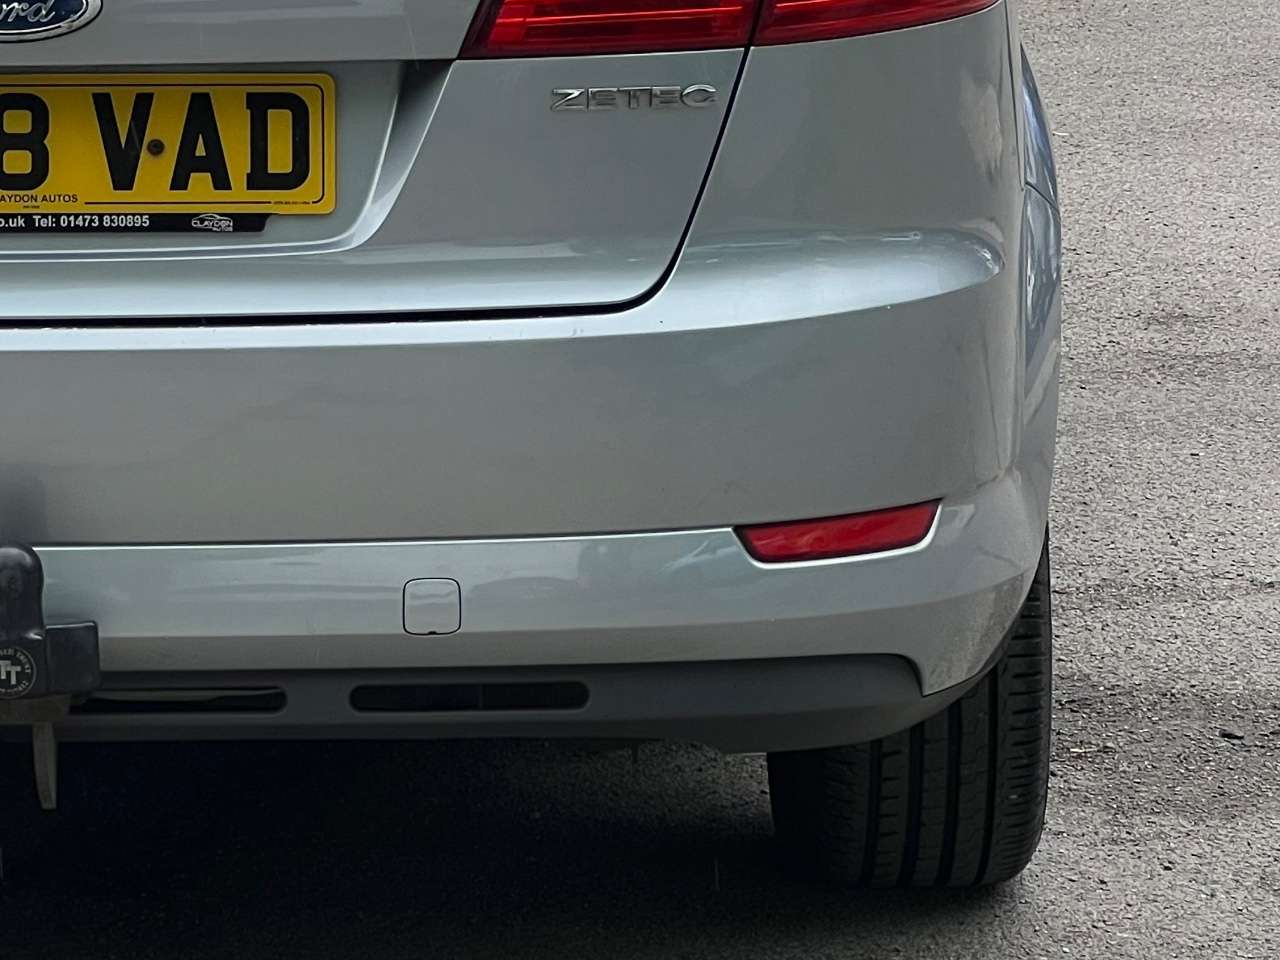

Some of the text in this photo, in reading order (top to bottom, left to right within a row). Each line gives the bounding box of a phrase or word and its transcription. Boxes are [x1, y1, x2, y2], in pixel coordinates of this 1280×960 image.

[550, 83, 719, 112] ZETEC
[90, 91, 310, 192] VAD
[40, 193, 79, 204] AUTOS
[32, 215, 57, 228] Tel:
[59, 215, 99, 228] 01473
[102, 215, 150, 228] 830895
